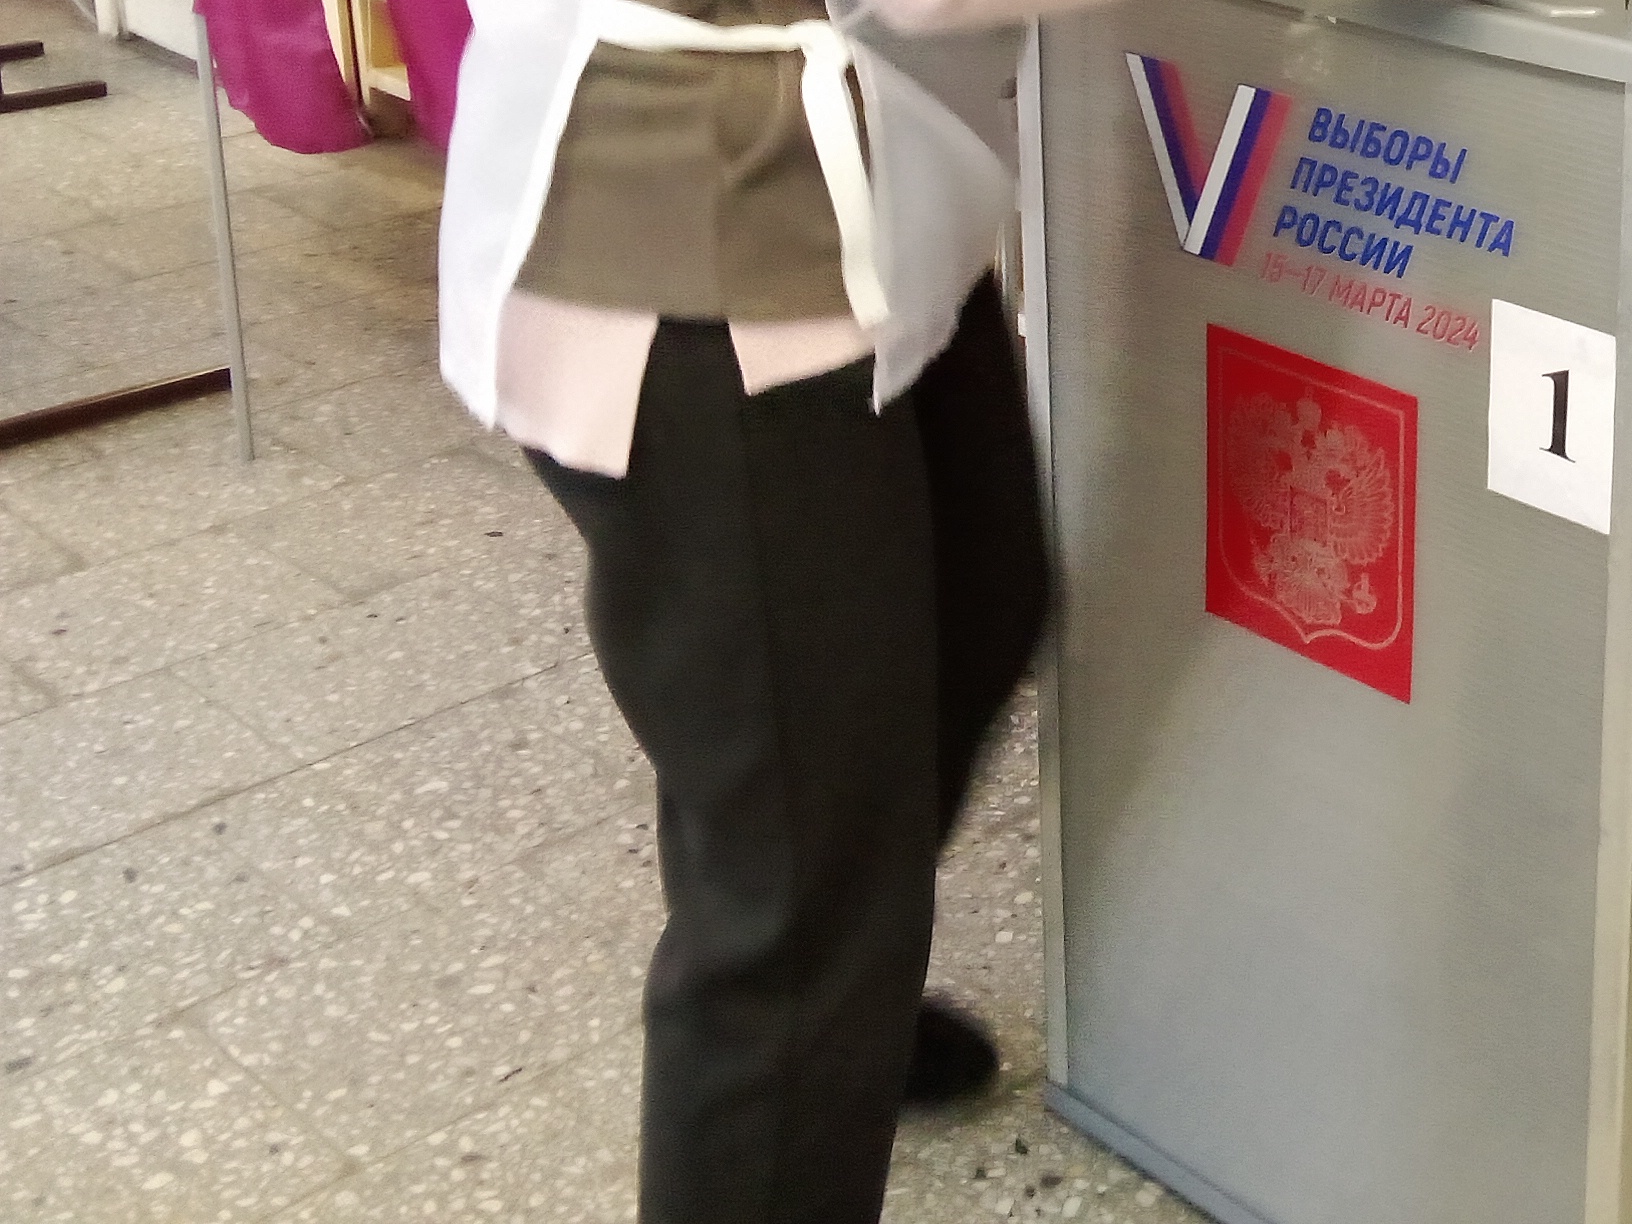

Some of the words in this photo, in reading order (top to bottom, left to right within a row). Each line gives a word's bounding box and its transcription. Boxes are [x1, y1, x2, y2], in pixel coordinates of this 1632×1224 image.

[1307, 106, 1468, 184] ВЫБОРЫ
[1273, 205, 1414, 279] РОССИИ
[1290, 157, 1516, 257] ПРЕЗИДЕНТА
[1327, 274, 1413, 328] МАРТА
[1416, 305, 1481, 352] 2024
[1538, 369, 1577, 464] 1
